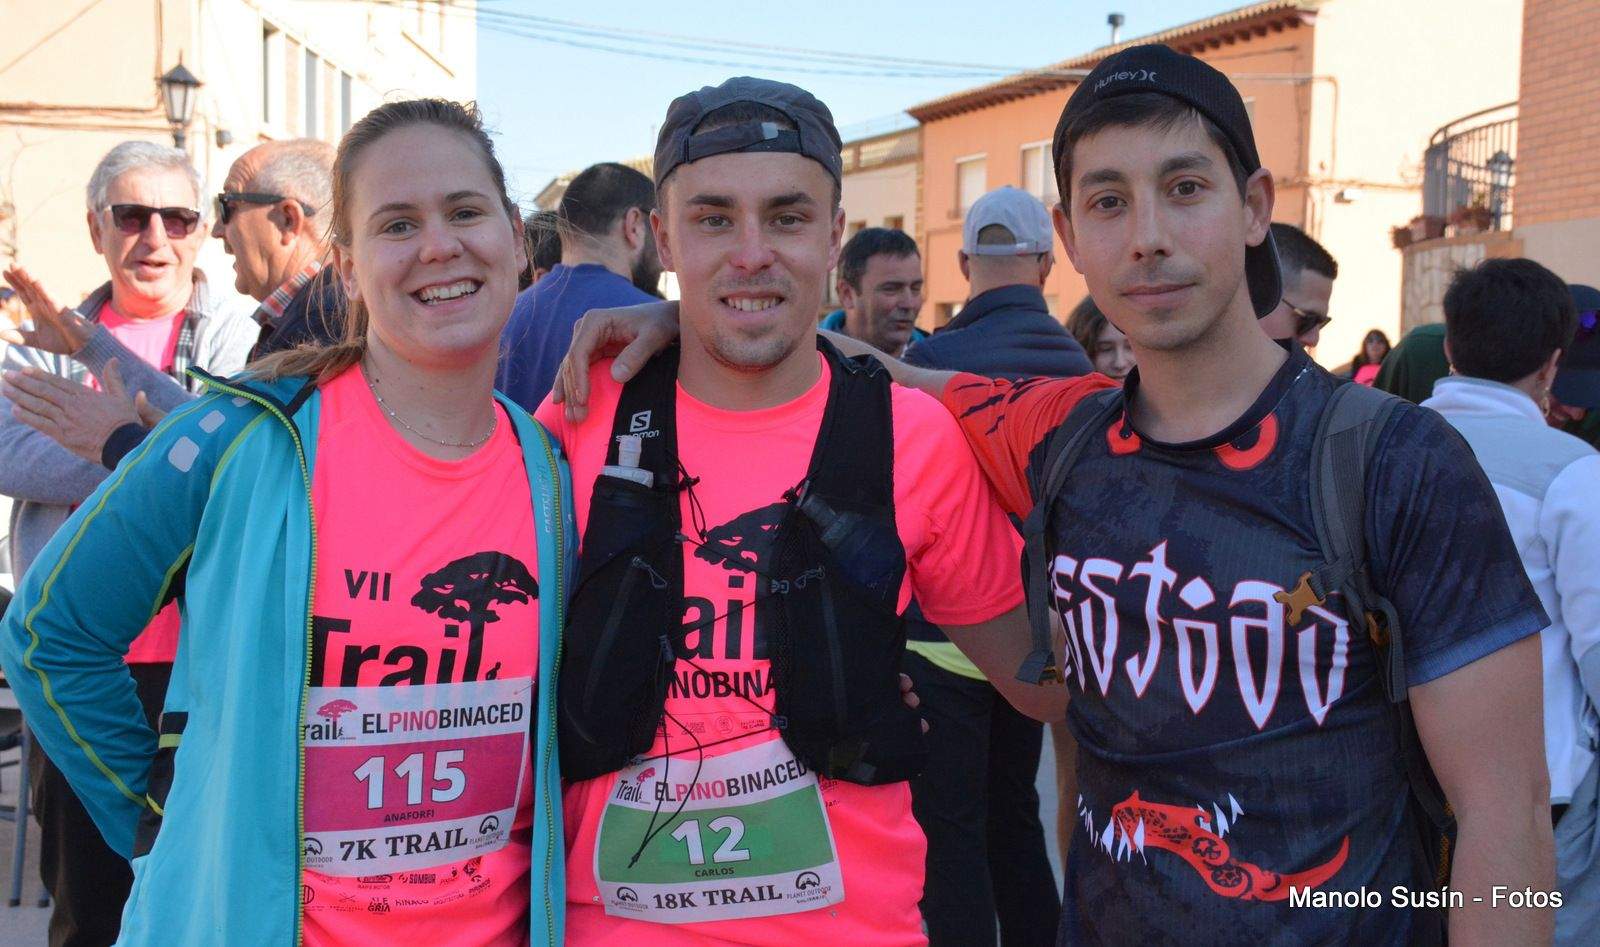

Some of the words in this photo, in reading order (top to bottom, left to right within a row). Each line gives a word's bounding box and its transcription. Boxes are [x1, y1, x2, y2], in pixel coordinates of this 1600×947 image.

[1094, 71, 1139, 92] Hurley
[344, 568, 391, 602] VII
[674, 574, 772, 660] ail
[303, 718, 338, 741] rail
[353, 749, 467, 810] 115
[339, 838, 377, 862] 7K
[385, 827, 469, 857] TRAIL
[670, 815, 751, 866] 12
[694, 867, 735, 878] CARLOS
[652, 893, 697, 910] 18K
[703, 884, 783, 906] TRAIL
